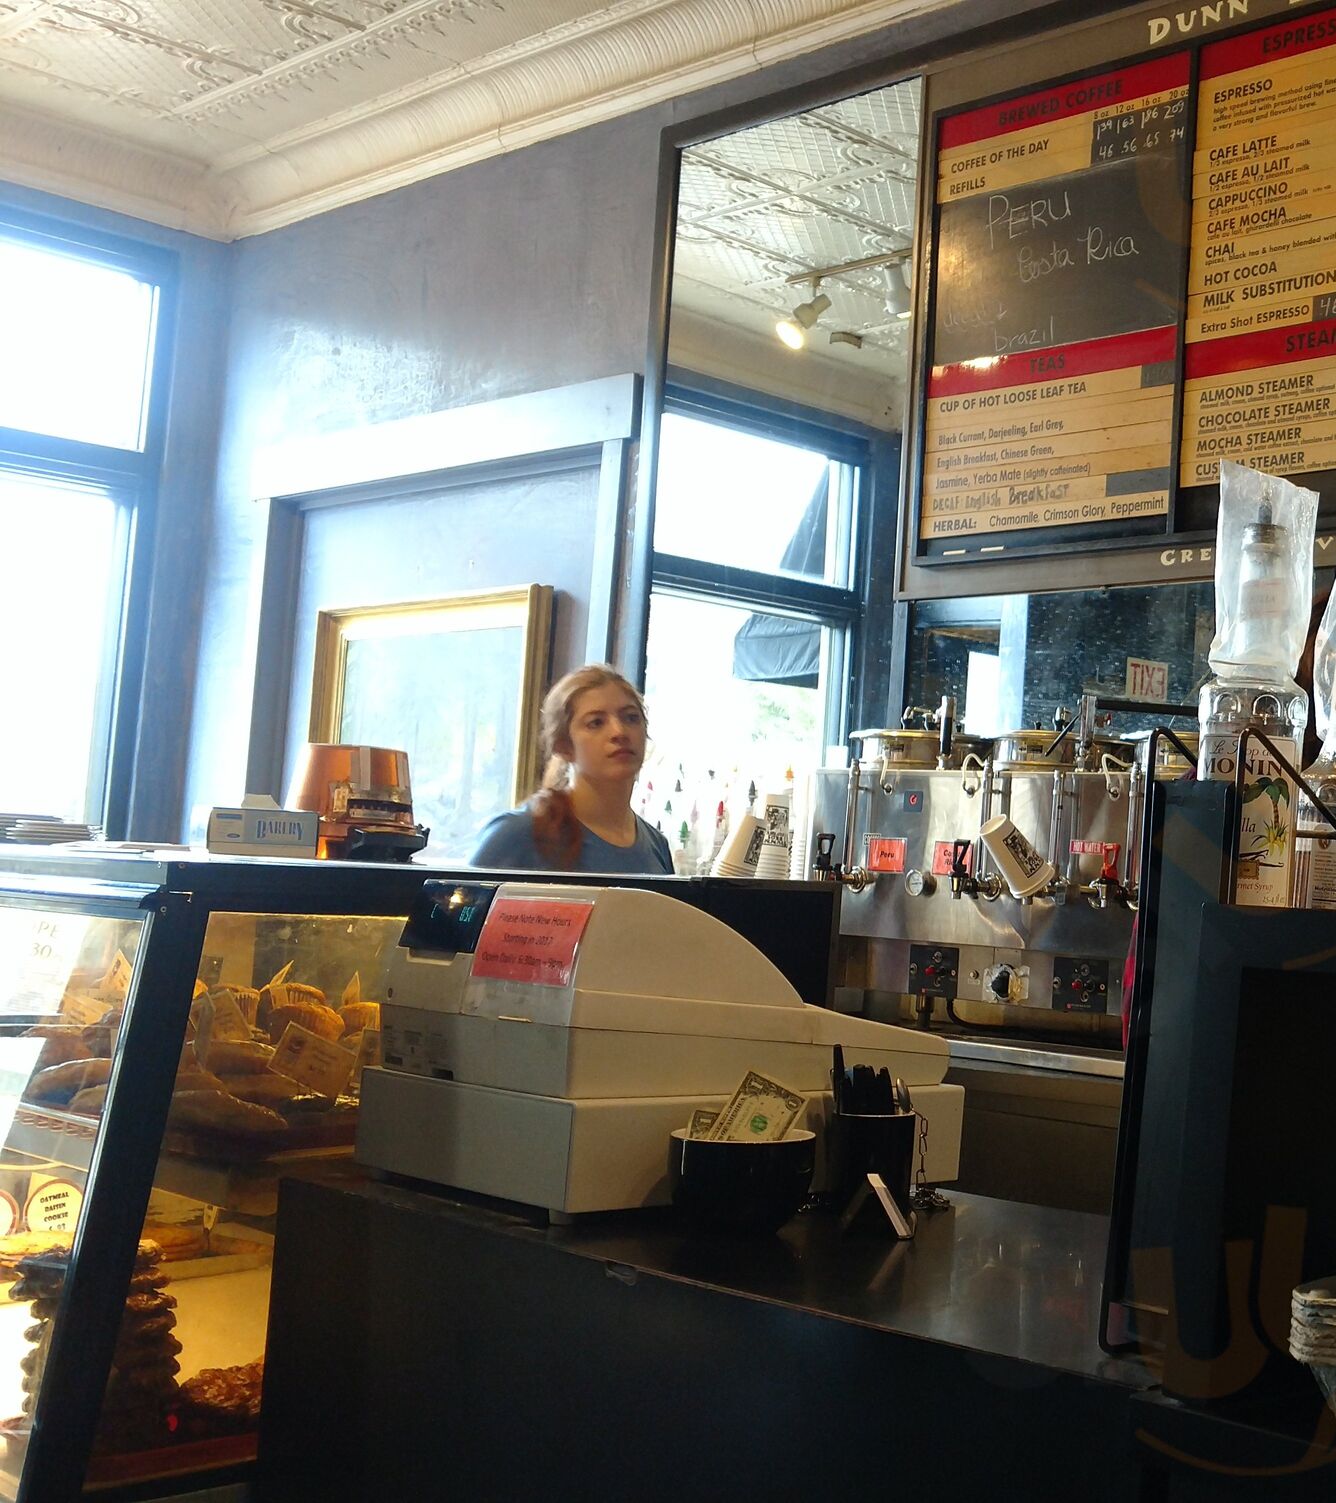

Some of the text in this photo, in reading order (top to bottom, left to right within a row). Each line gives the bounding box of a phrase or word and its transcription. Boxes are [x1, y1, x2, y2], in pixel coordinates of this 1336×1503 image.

[1148, 0, 1248, 45] DUNN
[998, 80, 1123, 127] BREWED COFFEE
[1214, 79, 1272, 104] ESPRESSO
[951, 138, 1050, 174] COFFEE OF THE DAY
[1209, 144, 1238, 162] CAFE
[1242, 135, 1277, 154] LATTE
[950, 176, 986, 195] REFILLS
[1209, 169, 1238, 186] CAFE
[1241, 164, 1259, 179] AU
[1264, 157, 1290, 174] LAIT
[1208, 182, 1288, 211] CAPPUCCINO
[986, 192, 1072, 249] PERU
[1206, 218, 1236, 234] CAFE
[1240, 206, 1287, 227] MOCHA
[1078, 226, 1140, 264] Rica
[1206, 242, 1235, 258] CHAI
[1204, 261, 1278, 286] HOT COCOA
[1203, 270, 1336, 308] MILK SUBSTITUTION
[1201, 304, 1310, 334] Extra Shot ESPRESSO
[1030, 354, 1066, 375] TEAS
[940, 382, 1086, 413] CUP OF HOT LOOSE LEAF TEA
[1200, 384, 1254, 403] ALMOND
[1258, 374, 1314, 394] STEAMER
[1198, 406, 1270, 428] CHOCOLATE
[1274, 398, 1330, 417] STEAMER
[938, 419, 1064, 446] Black Currant, Darjeeling, Earl Grey,
[1196, 436, 1242, 452] MOCHA
[1246, 427, 1302, 446] STEAMER
[937, 444, 1055, 470] English Breakfast, Chinese Green,
[1250, 452, 1305, 470] STEAMER
[936, 475, 970, 490] Jasmine,
[972, 470, 998, 484] Yerba
[1000, 468, 1022, 482] Mate
[1024, 465, 1048, 481] (slightly
[933, 519, 976, 532] HERBAL:
[1044, 508, 1079, 522] Crimson
[1110, 498, 1164, 516] Peppermint
